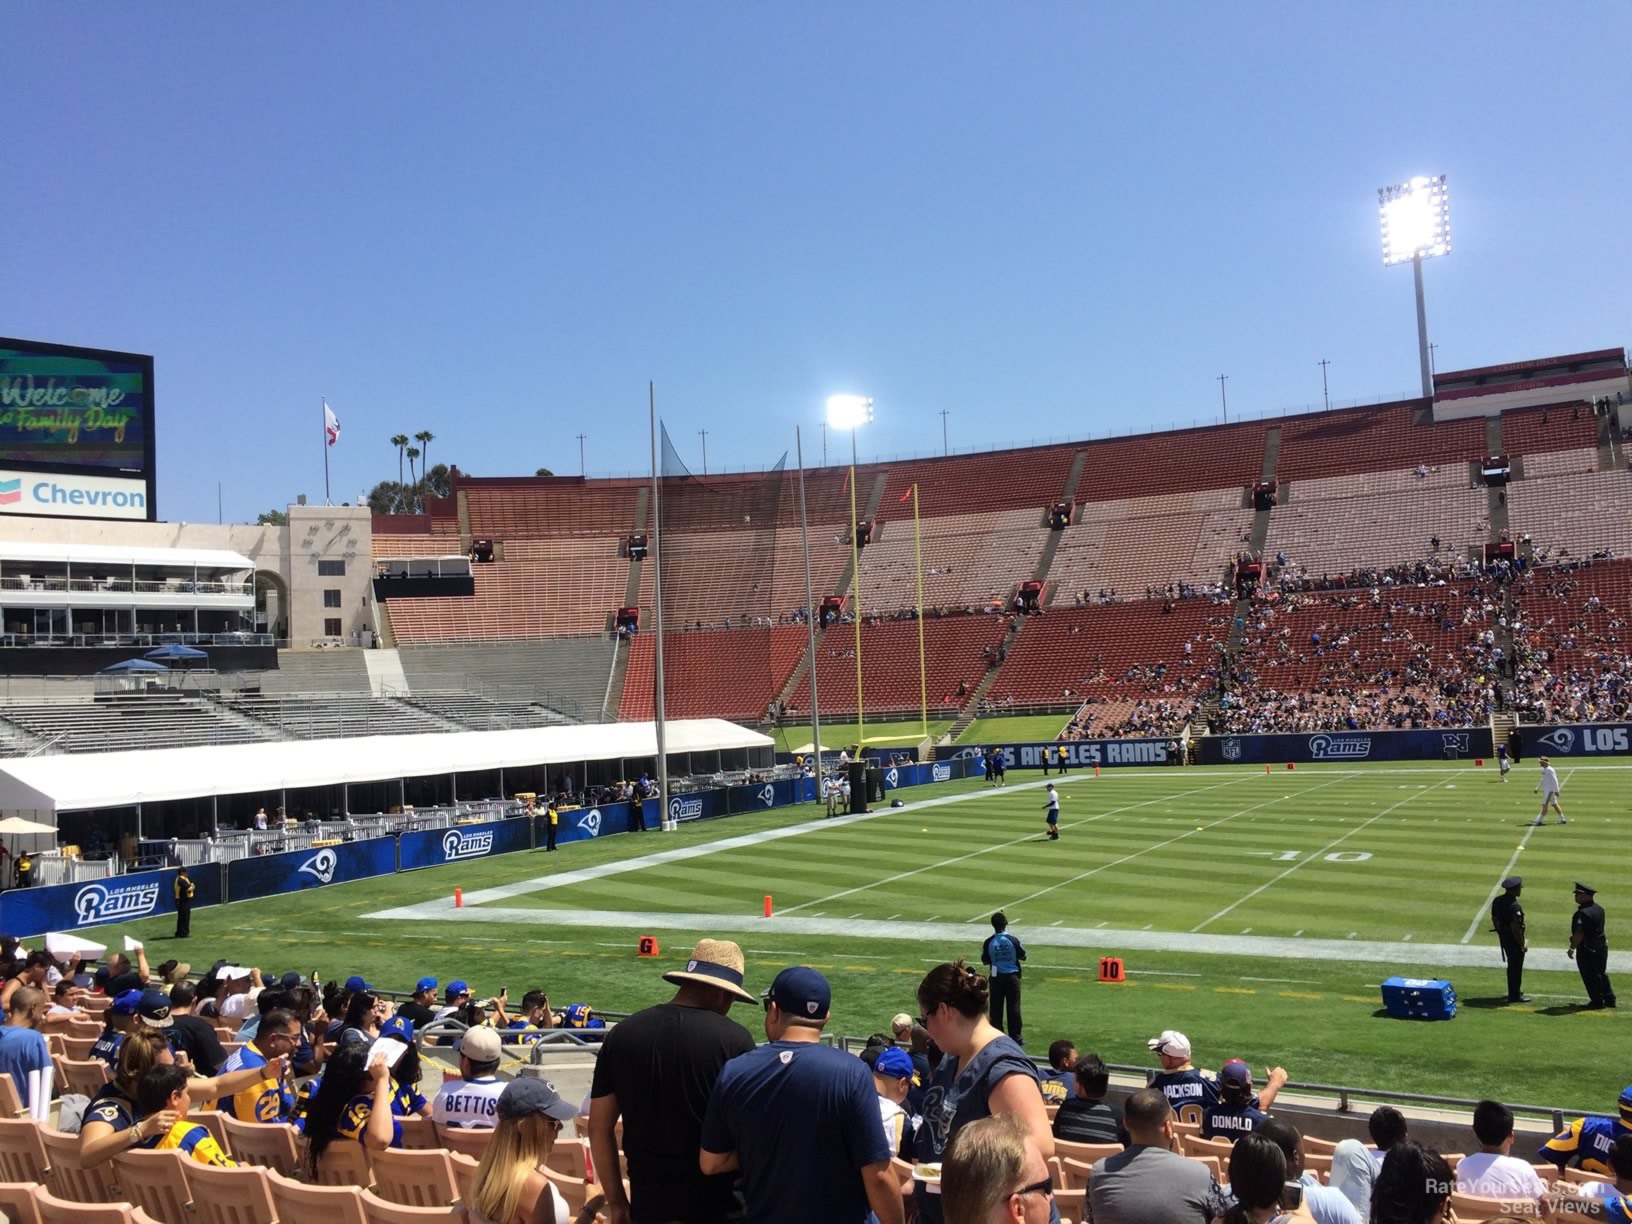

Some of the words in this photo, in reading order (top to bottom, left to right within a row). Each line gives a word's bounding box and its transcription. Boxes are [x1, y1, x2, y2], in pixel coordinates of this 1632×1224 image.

[1, 374, 125, 408] Welcome
[17, 407, 82, 444] Family
[84, 406, 130, 444] Day
[32, 482, 145, 508] Chevron
[1309, 735, 1371, 758] Rams
[1583, 728, 1629, 751] LOS
[1107, 742, 1167, 763] RAMS
[1223, 746, 1239, 757] NFL
[443, 830, 493, 860] Rams
[75, 884, 159, 925] Rams
[640, 938, 653, 954] G
[1101, 961, 1119, 978] 10
[259, 1092, 280, 1121] 29
[446, 1095, 497, 1116] BETTIS
[1212, 1115, 1252, 1131] DONALD
